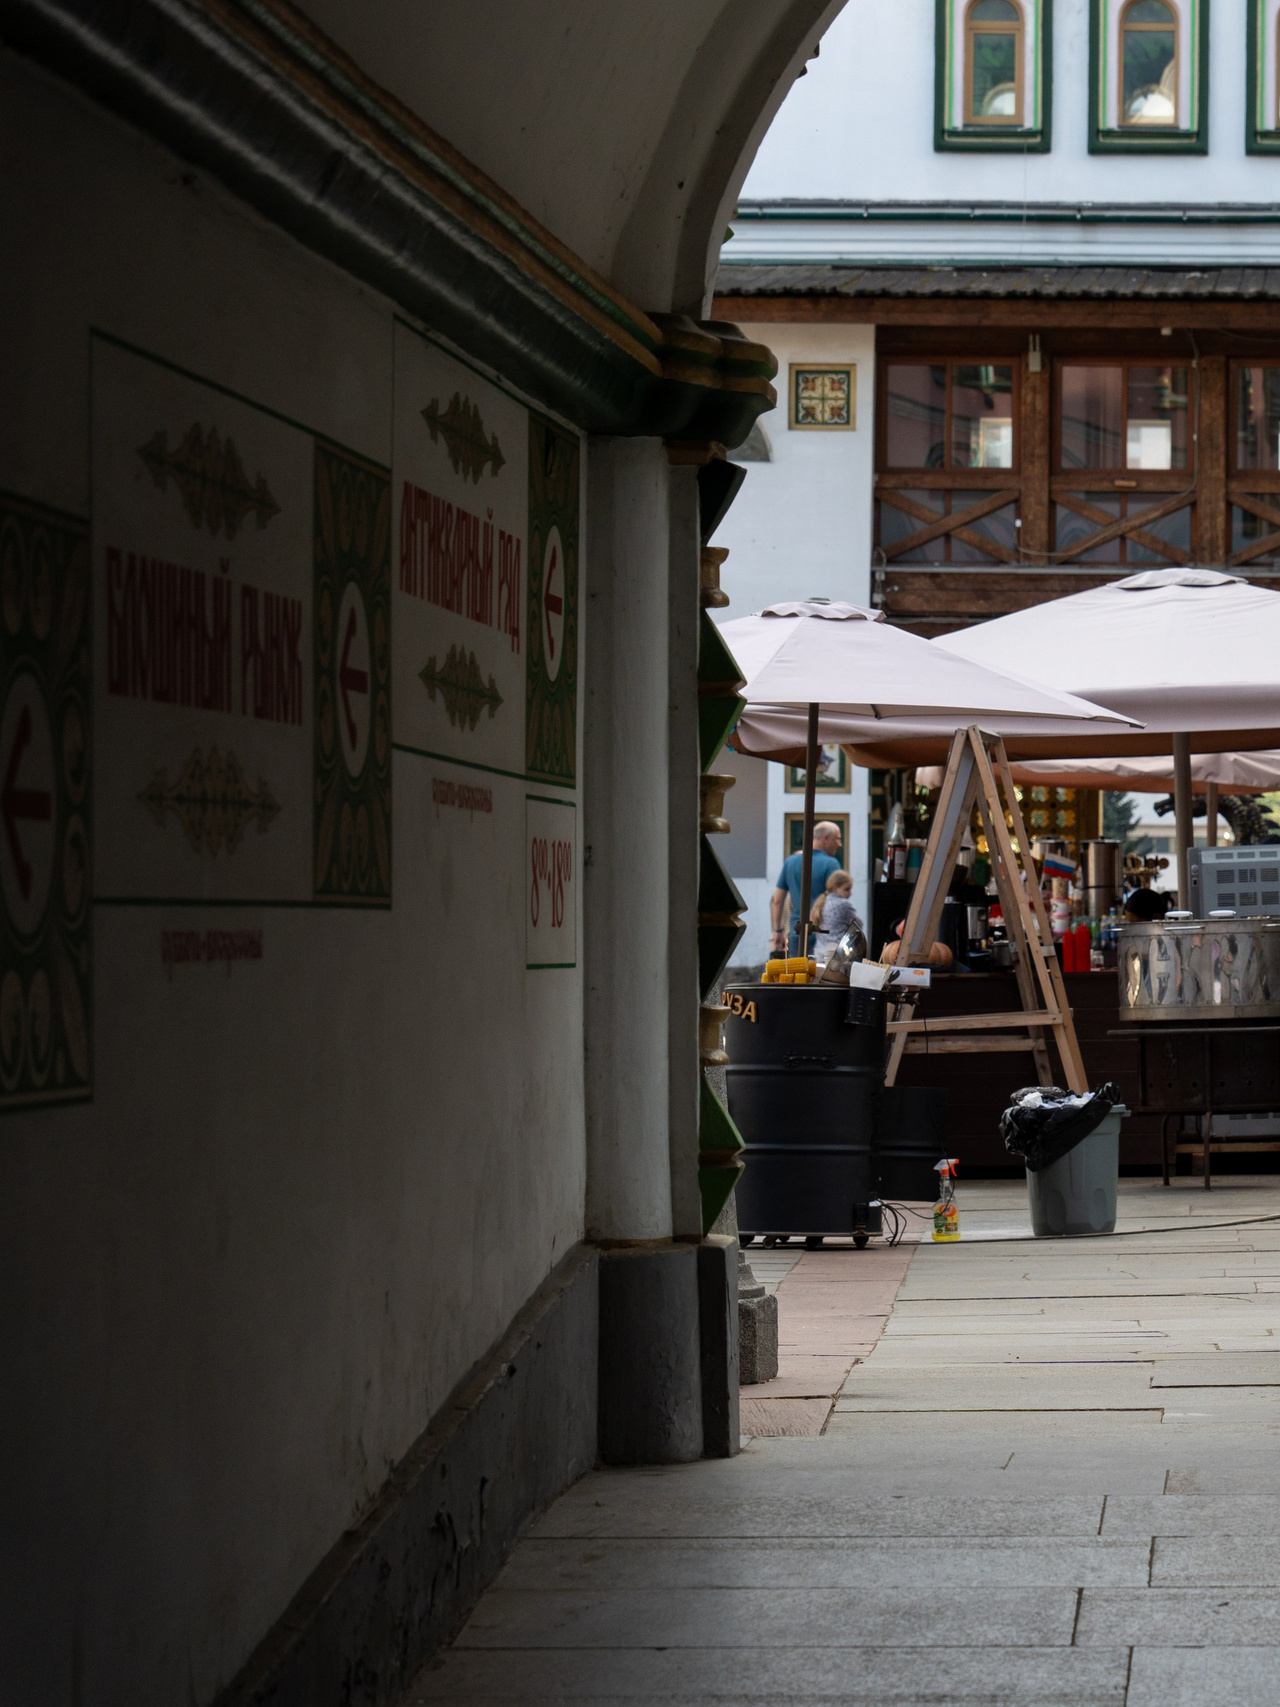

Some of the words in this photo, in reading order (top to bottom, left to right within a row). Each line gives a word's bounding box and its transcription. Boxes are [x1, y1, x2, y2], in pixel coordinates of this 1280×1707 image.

[107, 546, 232, 713] БЛОШИНЫЙ
[241, 584, 303, 726] РЫНОК
[400, 480, 494, 627] АНТИКВАРНЫЙ
[498, 529, 521, 655] РЯД
